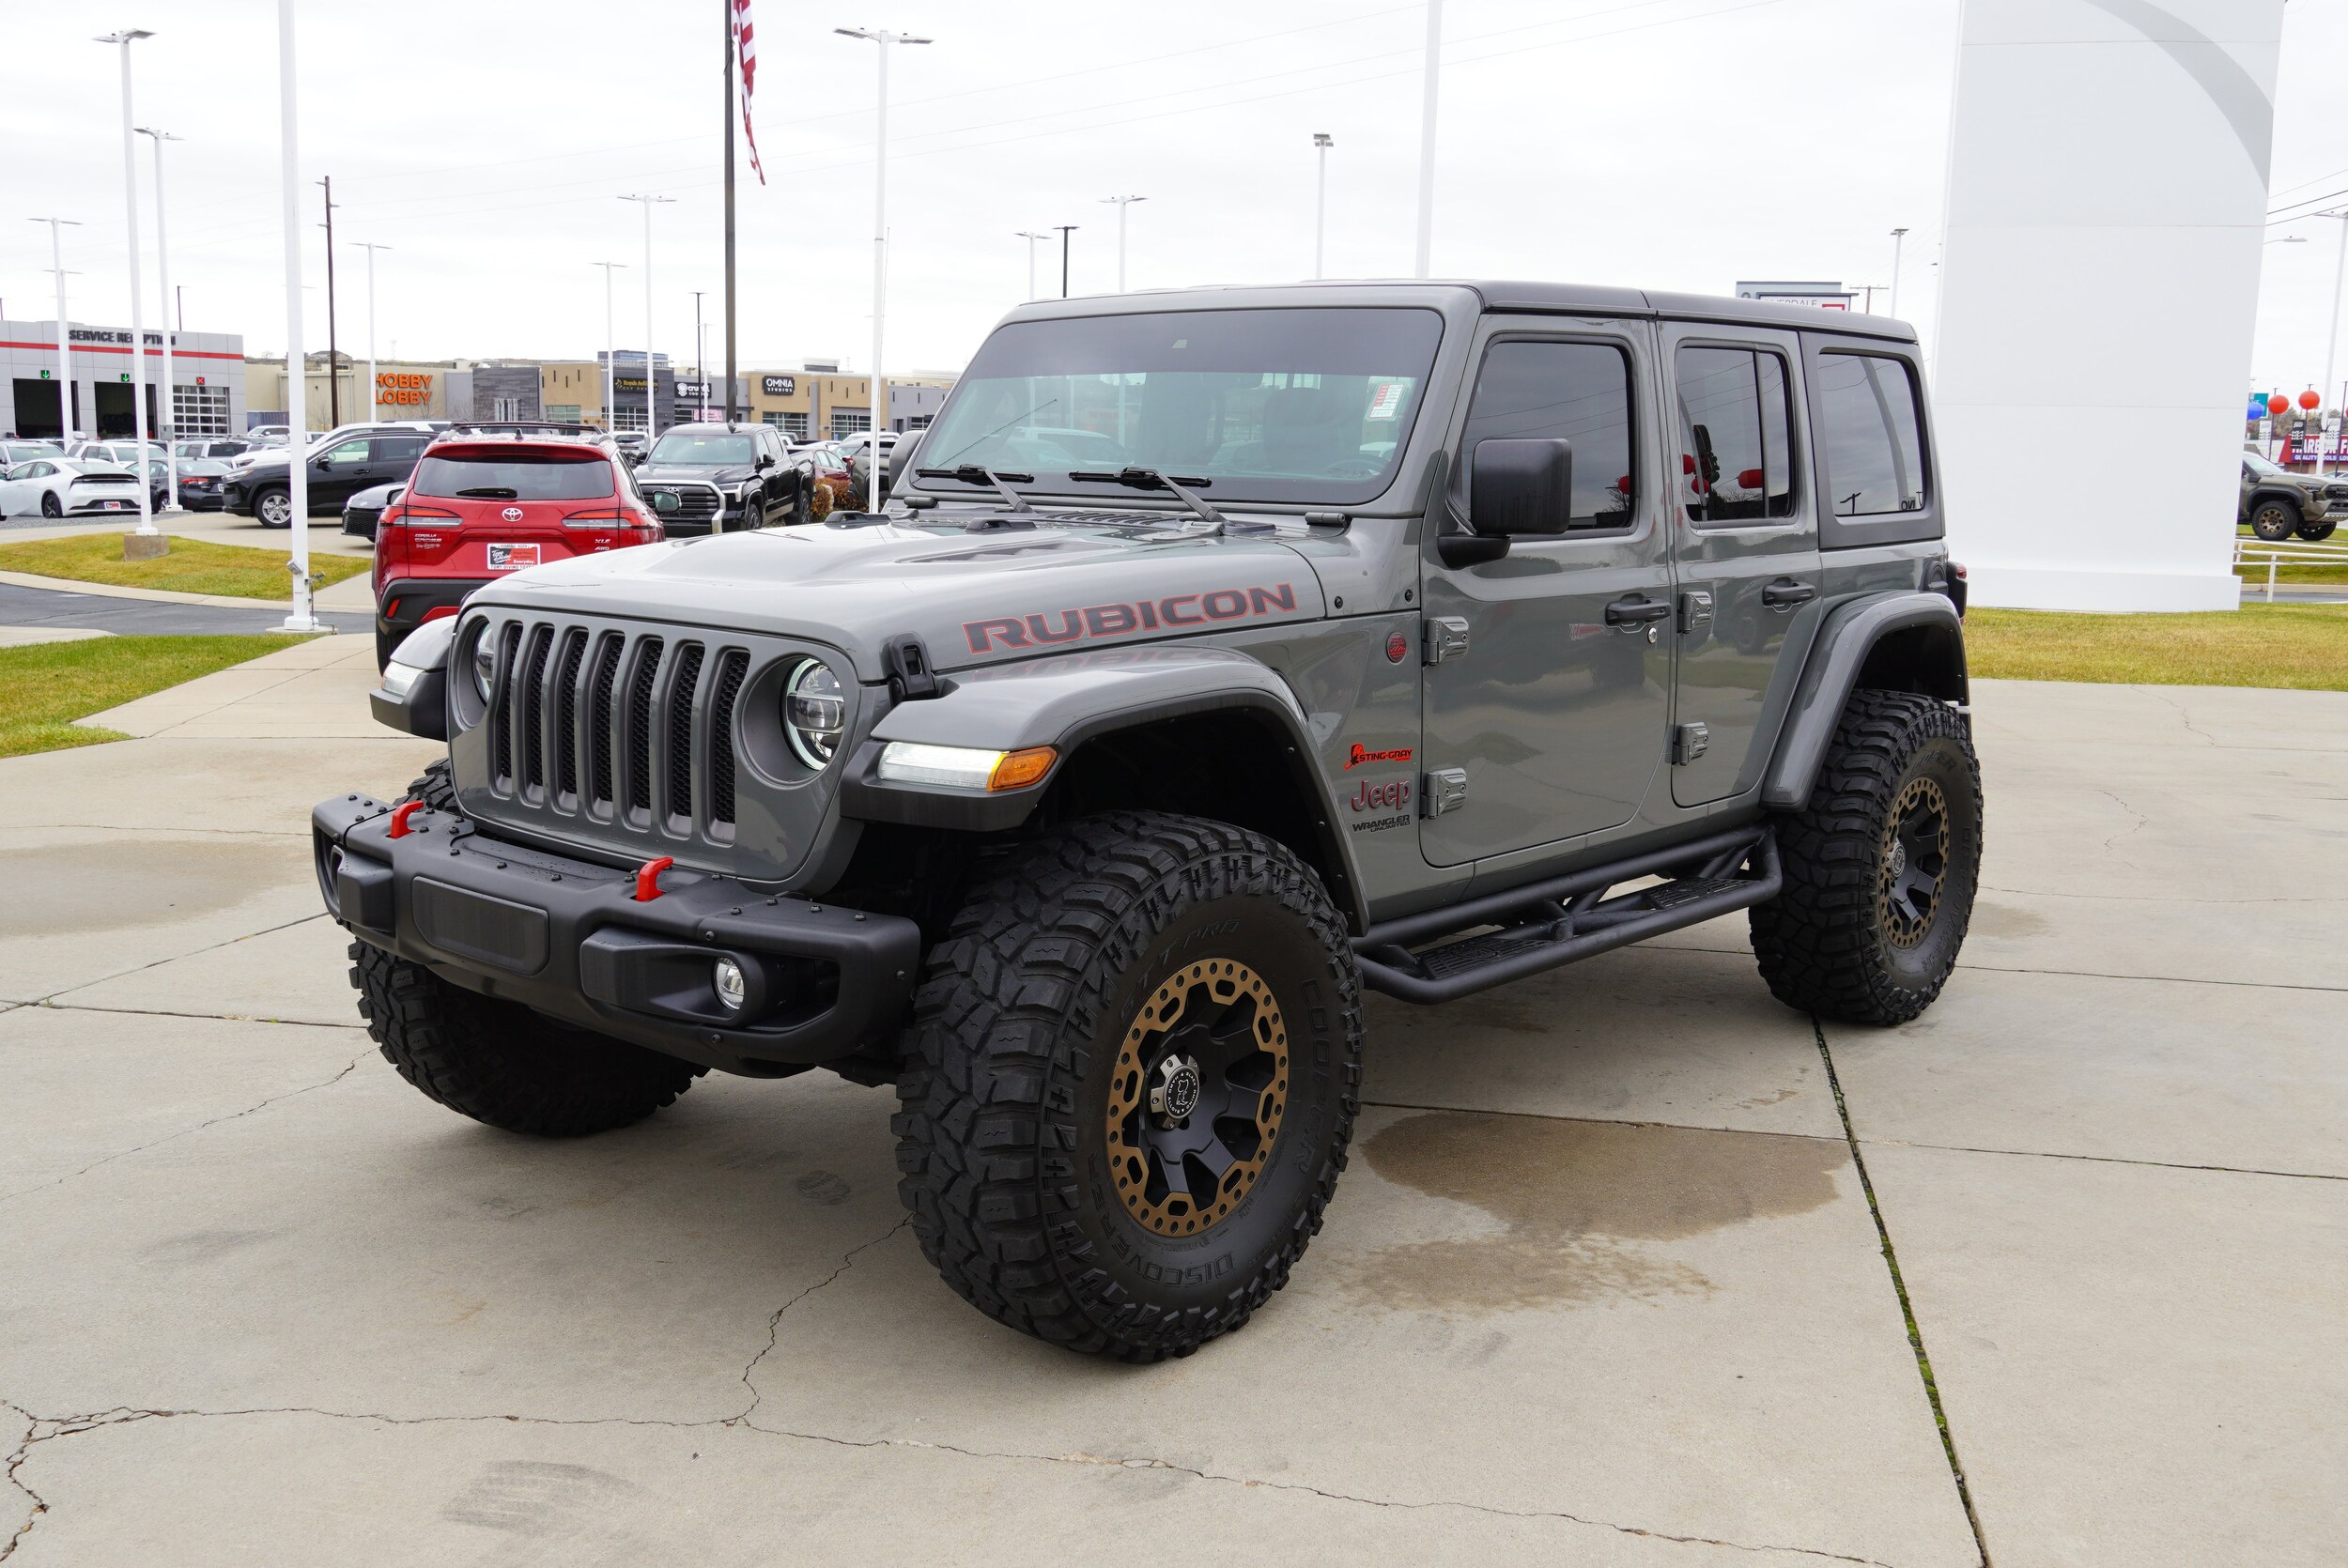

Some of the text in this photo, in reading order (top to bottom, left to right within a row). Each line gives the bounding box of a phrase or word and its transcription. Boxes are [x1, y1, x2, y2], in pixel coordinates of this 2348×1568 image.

[69, 330, 176, 346] SERVICE REPTIN
[376, 373, 433, 389] HOBBY
[766, 378, 794, 388] OMNIA
[376, 390, 432, 405] LOBBY
[962, 583, 1297, 654] RUBICON
[1359, 749, 1413, 761] STING-GRAY
[1352, 780, 1412, 812] Jeep
[1352, 814, 1411, 832] WRANGLER
[1370, 822, 1410, 833] UNLIMITED
[1292, 978, 1330, 1174] COOPER
[1088, 1150, 1234, 1288] DISCOVERER
